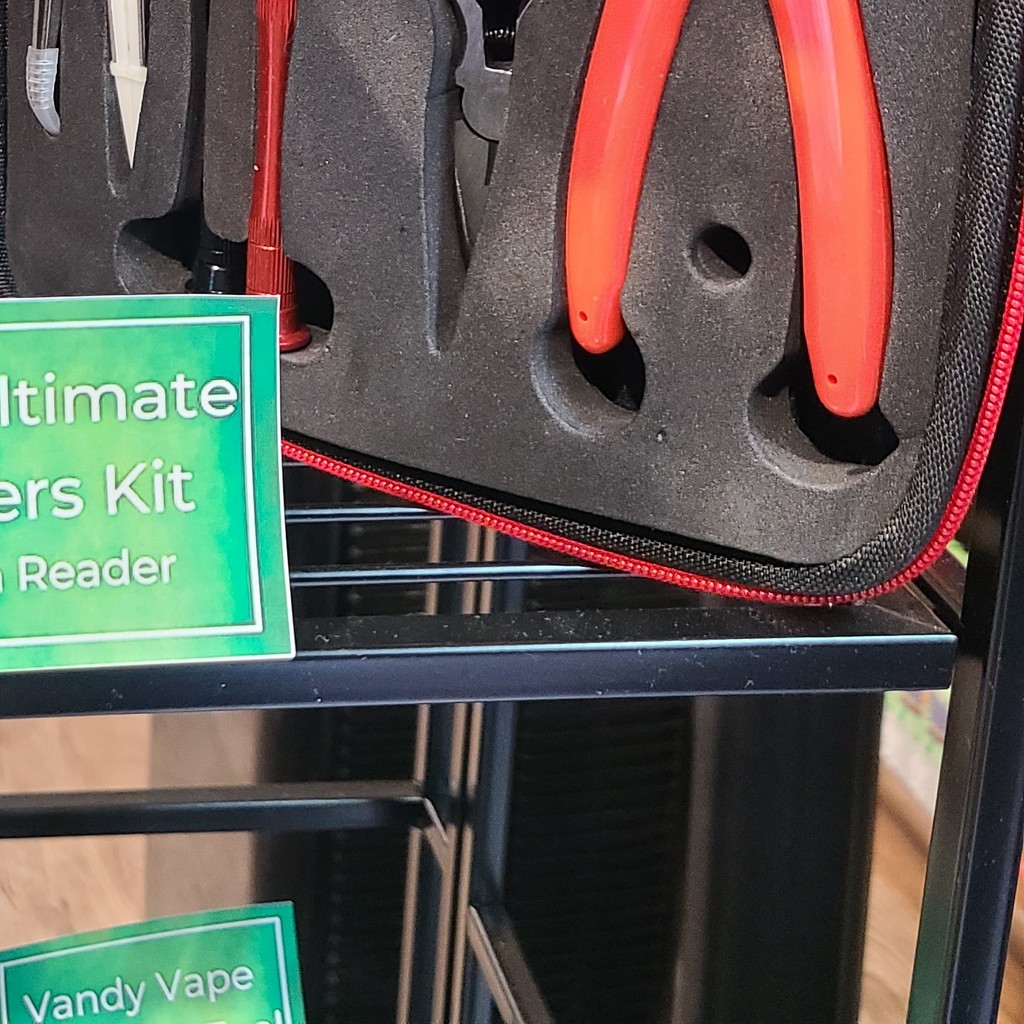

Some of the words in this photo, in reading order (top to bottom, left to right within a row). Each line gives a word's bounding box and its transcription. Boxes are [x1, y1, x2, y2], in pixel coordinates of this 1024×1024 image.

[105, 456, 196, 517] Kit
[17, 548, 177, 593] Reader
[23, 976, 146, 1023] Vandy
[153, 965, 255, 1003] Vape
